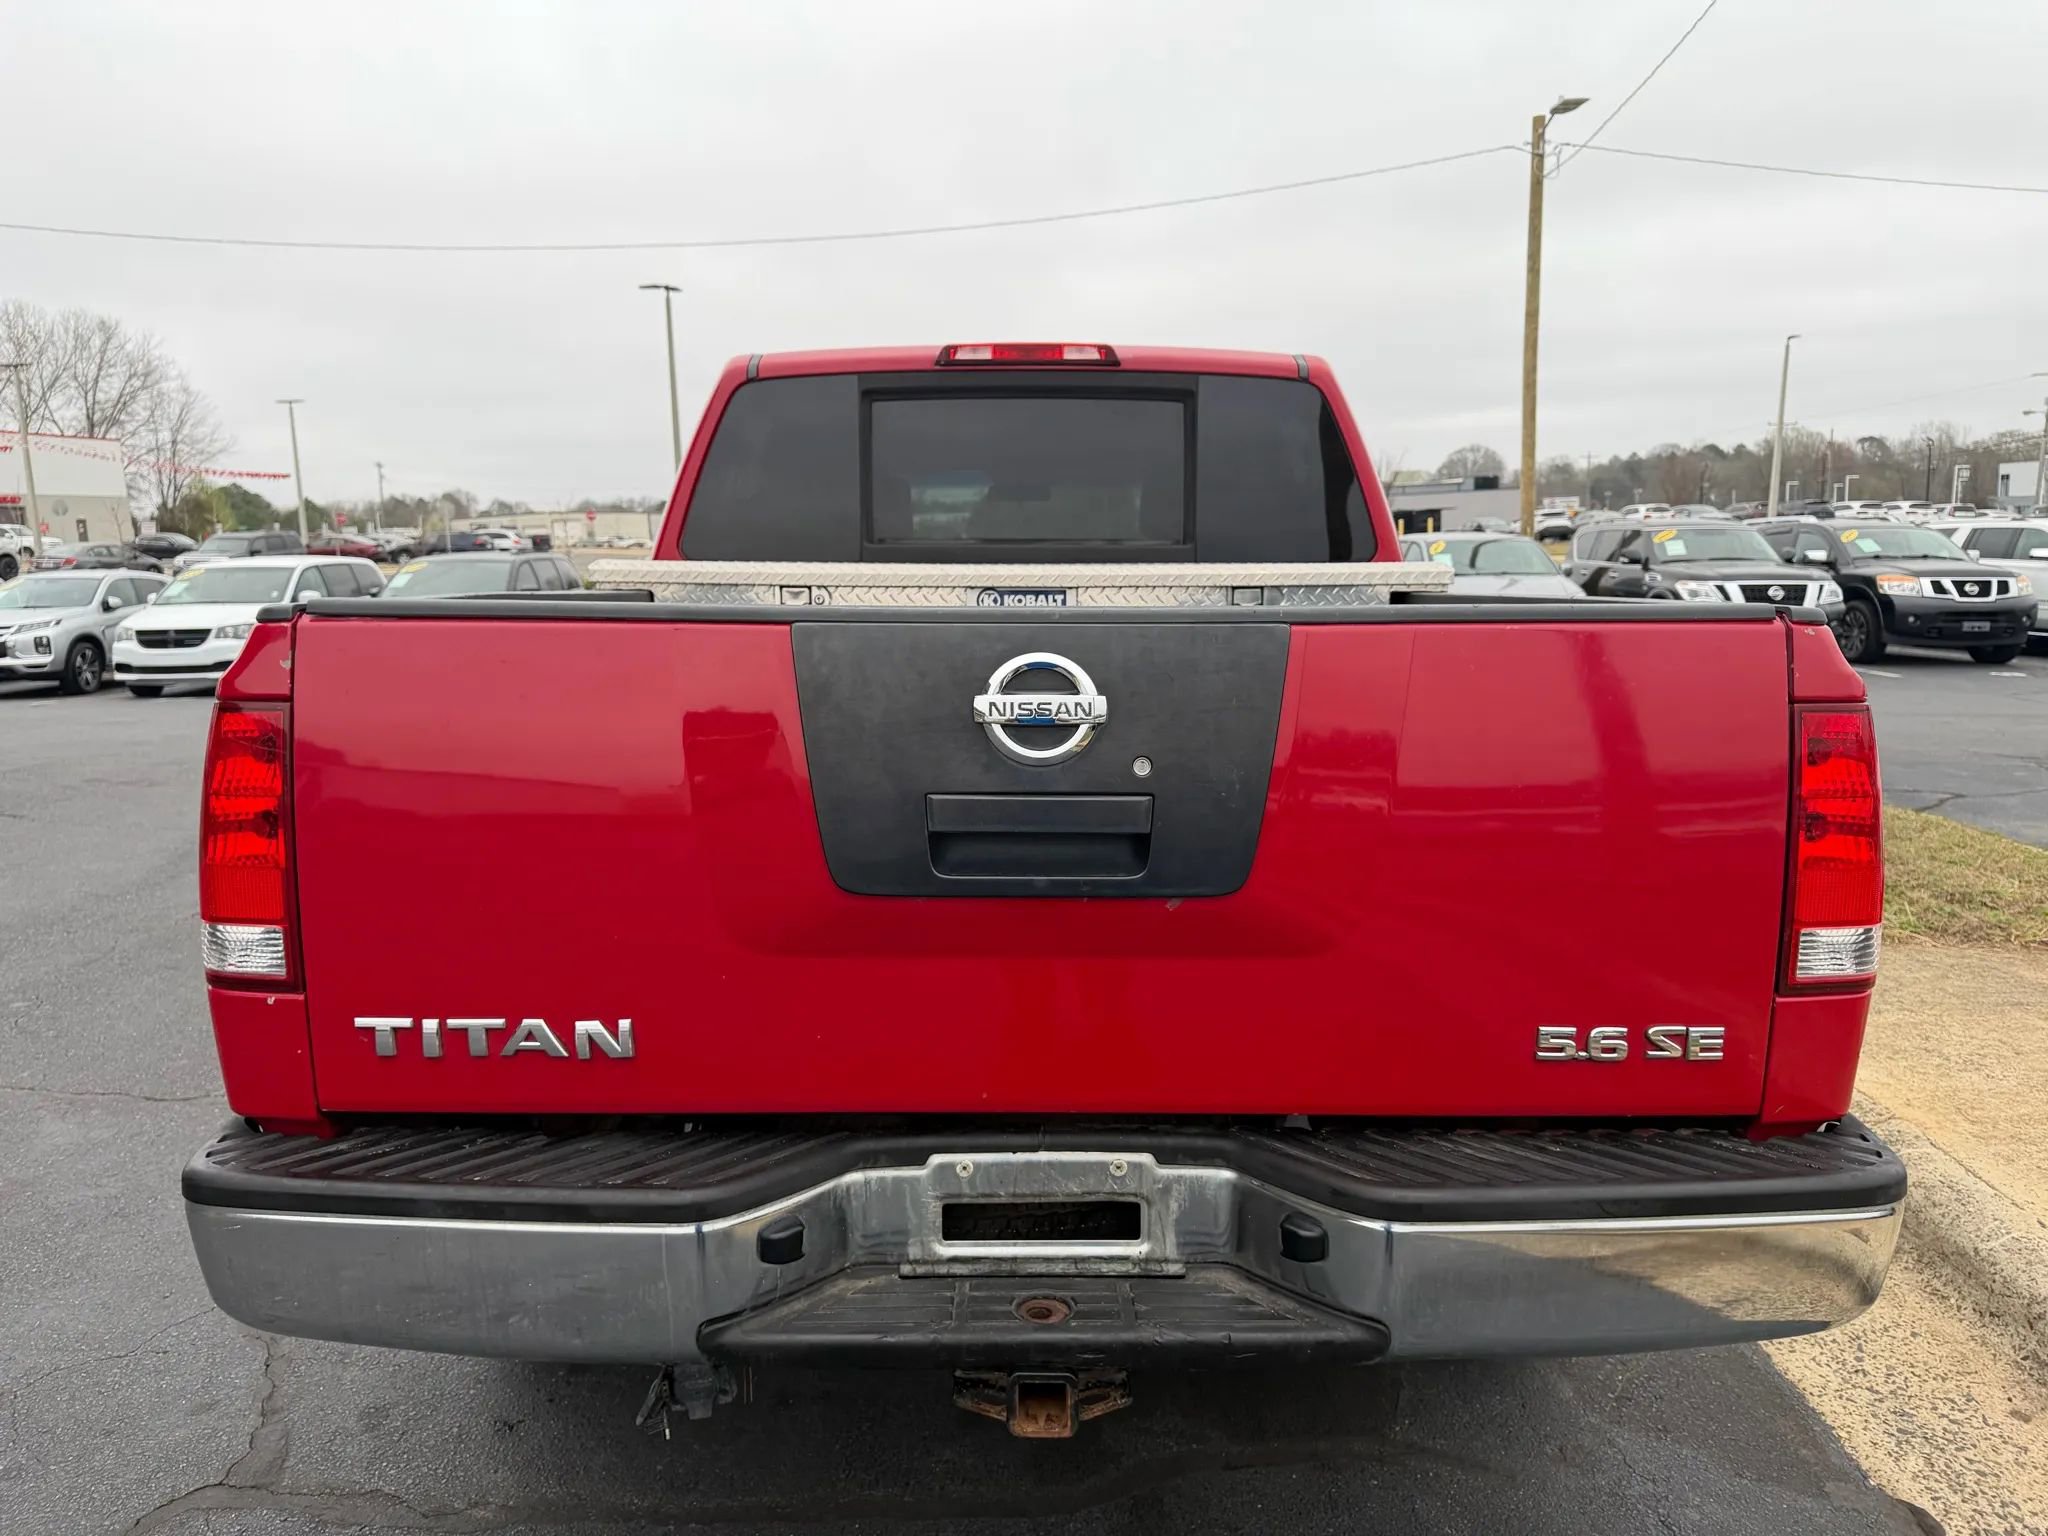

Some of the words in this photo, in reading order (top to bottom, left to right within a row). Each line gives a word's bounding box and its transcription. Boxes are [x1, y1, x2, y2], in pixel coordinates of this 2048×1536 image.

[1003, 594, 1064, 606] KOBALT
[988, 701, 1093, 718] NISSAN
[353, 1017, 636, 1060] TITAN
[1536, 1025, 1629, 1061] 5.6
[1646, 1025, 1725, 1061] SE
